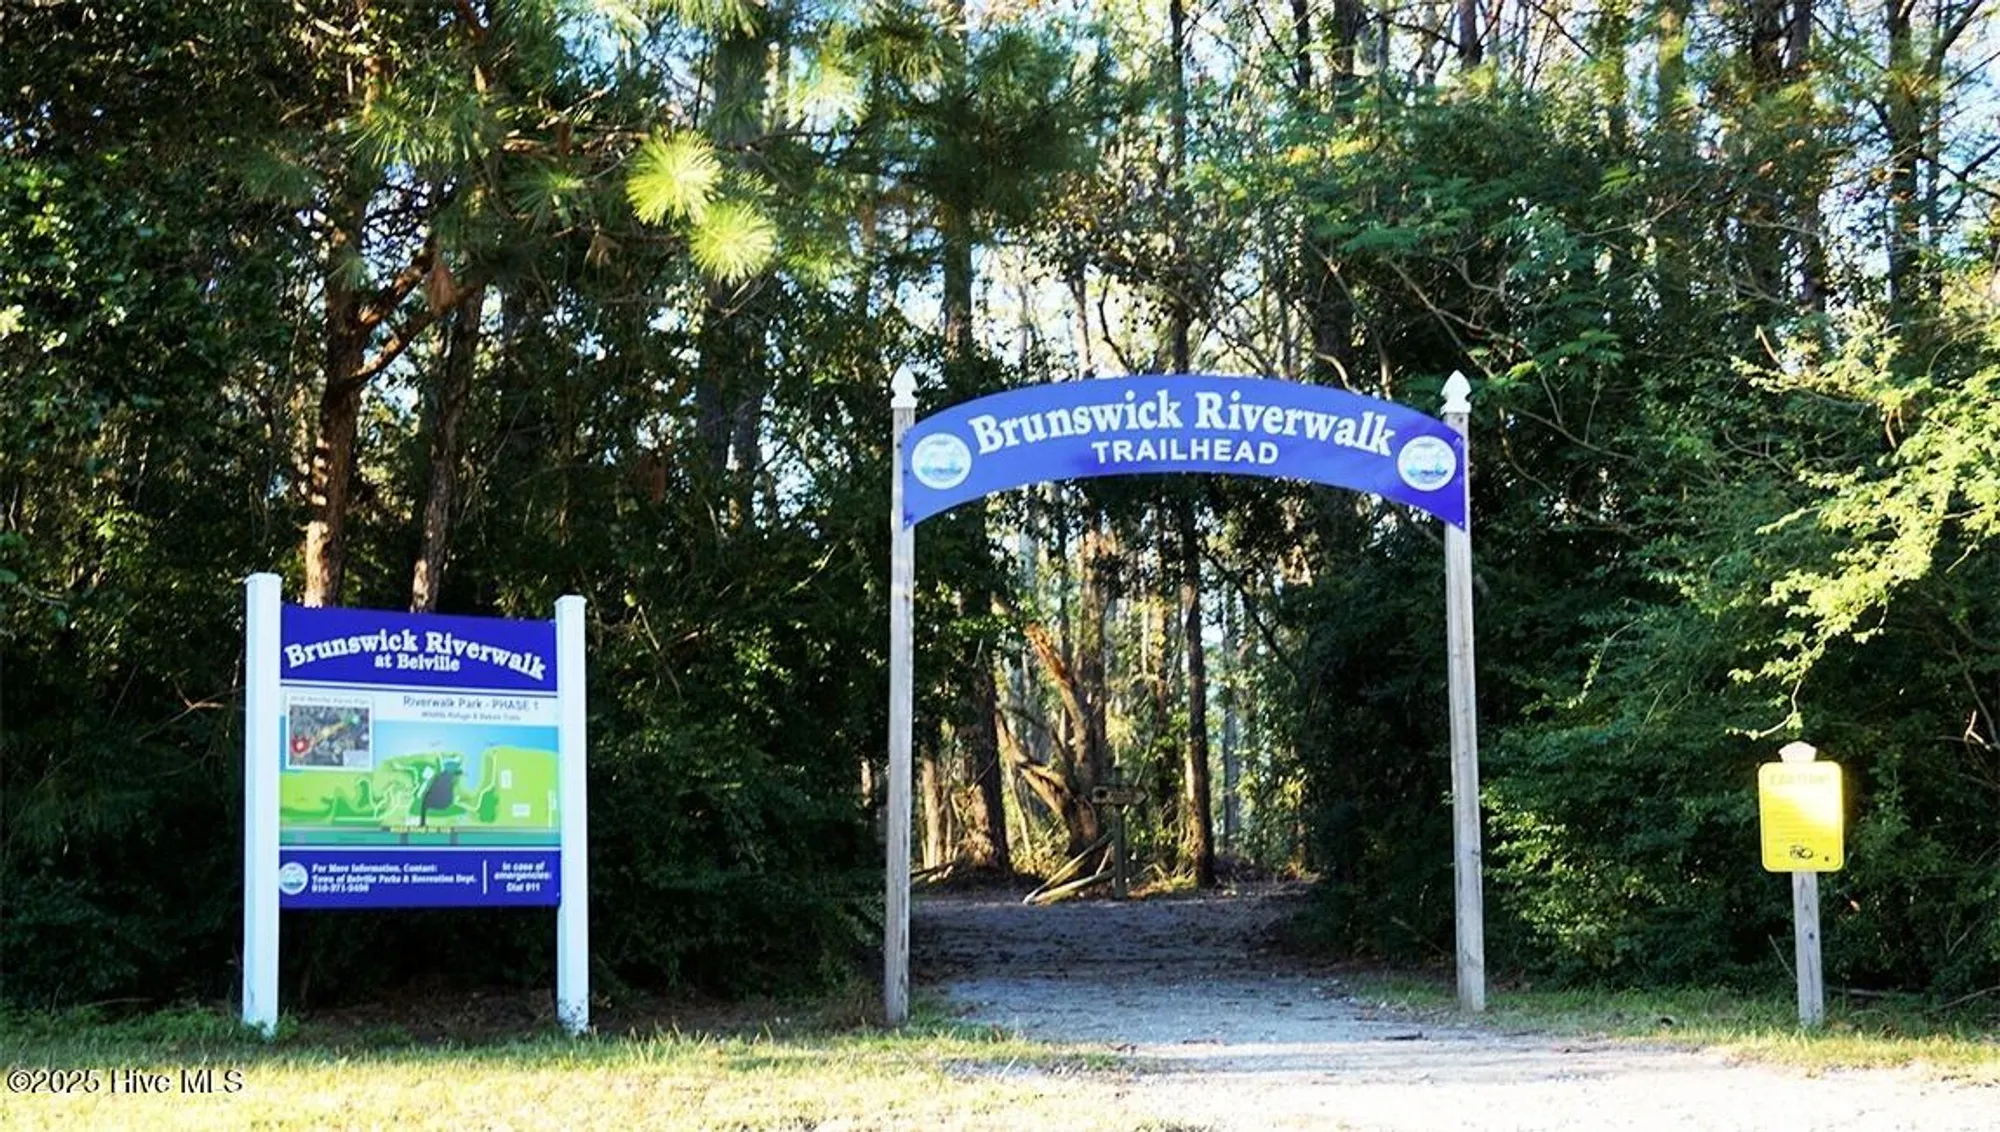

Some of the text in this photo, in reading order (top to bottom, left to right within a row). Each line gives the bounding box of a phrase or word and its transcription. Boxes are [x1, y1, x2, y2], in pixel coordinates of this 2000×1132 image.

[968, 390, 1396, 457] Brunswick Riverwalk
[1091, 437, 1279, 465] TRAILHEAD
[284, 629, 546, 680] Brunswick Riverwalk
[374, 654, 461, 672] at Belville
[403, 695, 455, 708] Riverwalk
[458, 698, 482, 709] Park
[492, 699, 529, 711] PHASE
[312, 864, 327, 873] For
[328, 864, 350, 873] More
[513, 863, 533, 871] case
[535, 861, 545, 871] of
[312, 874, 335, 884] Town
[335, 874, 346, 883] of
[379, 875, 401, 884] Parks
